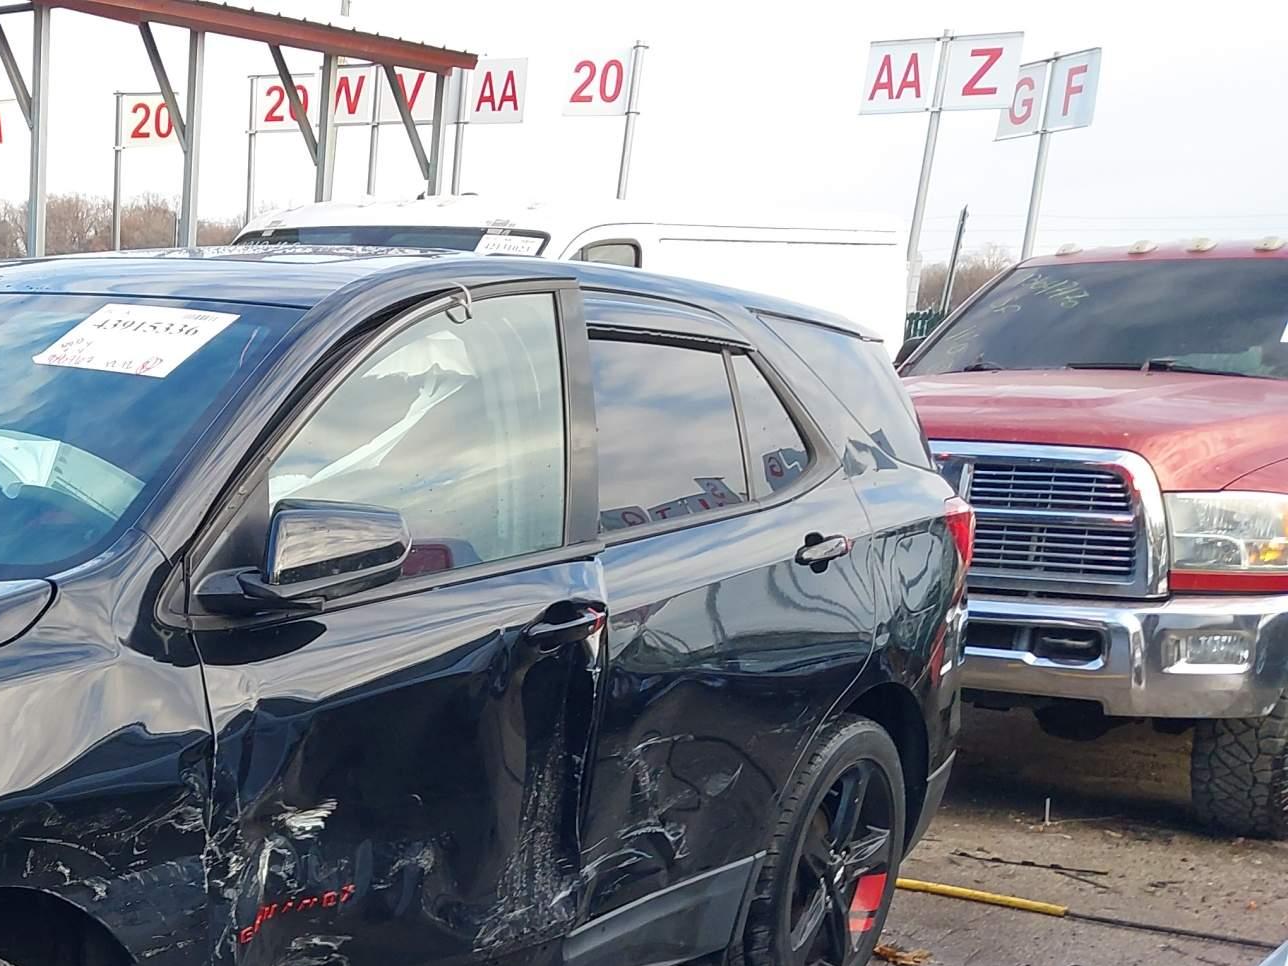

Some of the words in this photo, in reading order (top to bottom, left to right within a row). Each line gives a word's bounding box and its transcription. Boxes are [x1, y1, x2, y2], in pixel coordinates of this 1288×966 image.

[475, 70, 519, 112] AA
[569, 59, 623, 104] 20
[868, 53, 921, 101] AA
[961, 47, 1004, 97] Z
[1062, 64, 1088, 117] F
[130, 102, 174, 139] 20
[1008, 76, 1035, 125] G
